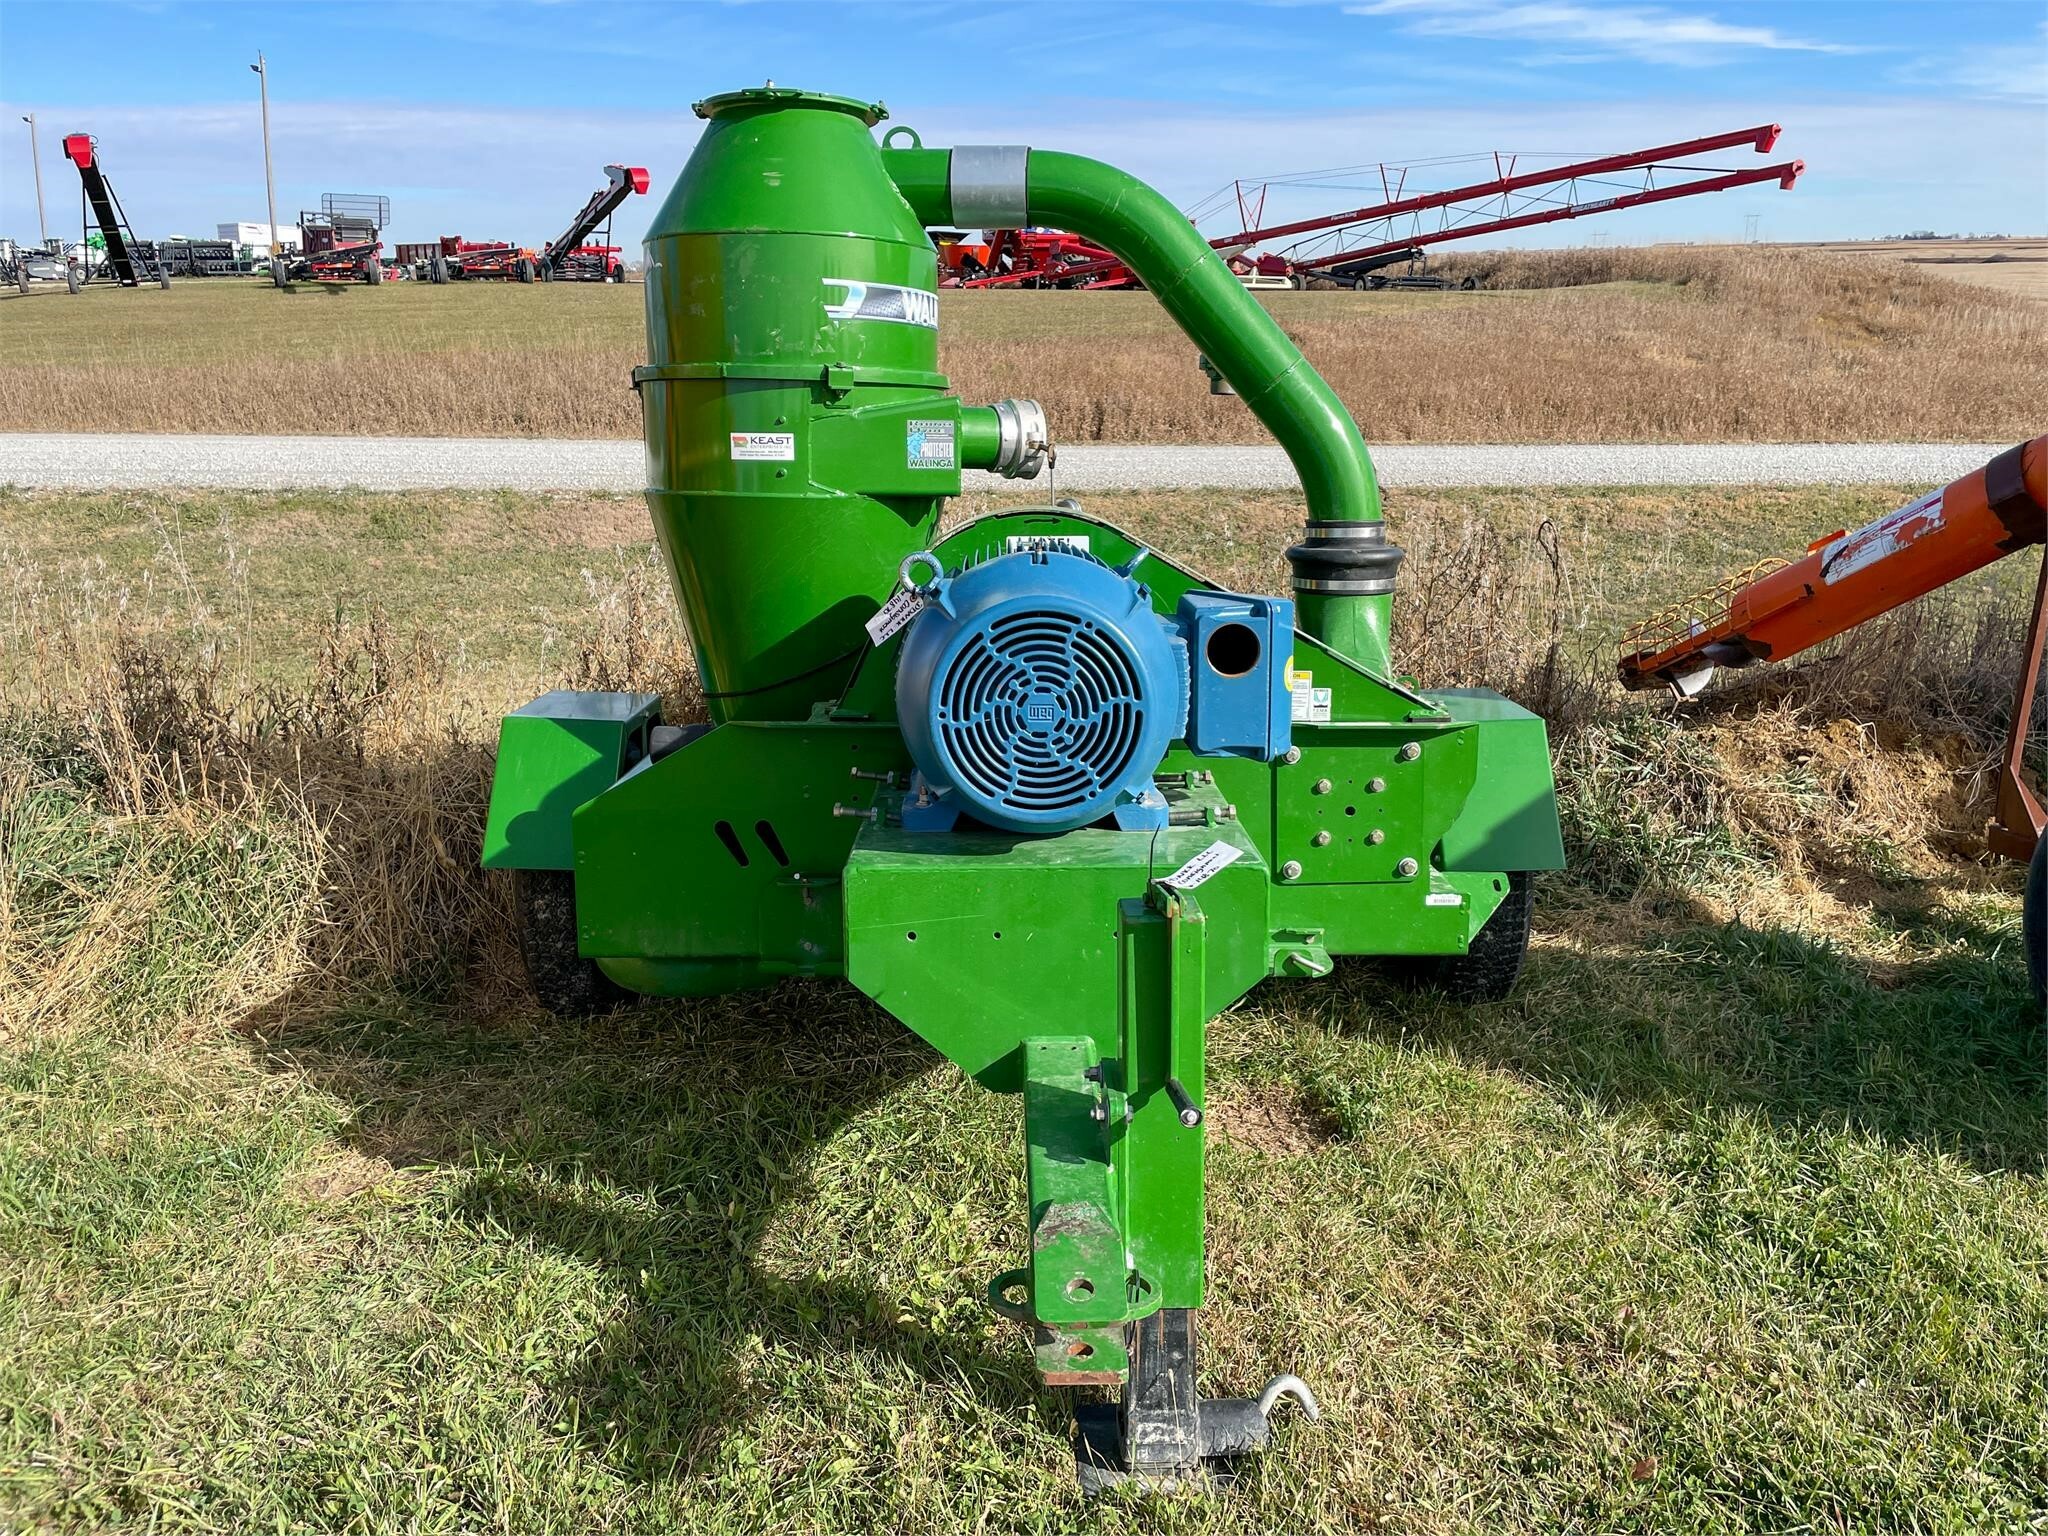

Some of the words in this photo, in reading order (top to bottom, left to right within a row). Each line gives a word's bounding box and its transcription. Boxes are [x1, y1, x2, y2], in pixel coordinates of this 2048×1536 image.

[750, 436, 792, 445] KEAST
[920, 443, 953, 457] PROTECTED
[909, 459, 953, 468] WALINGA
